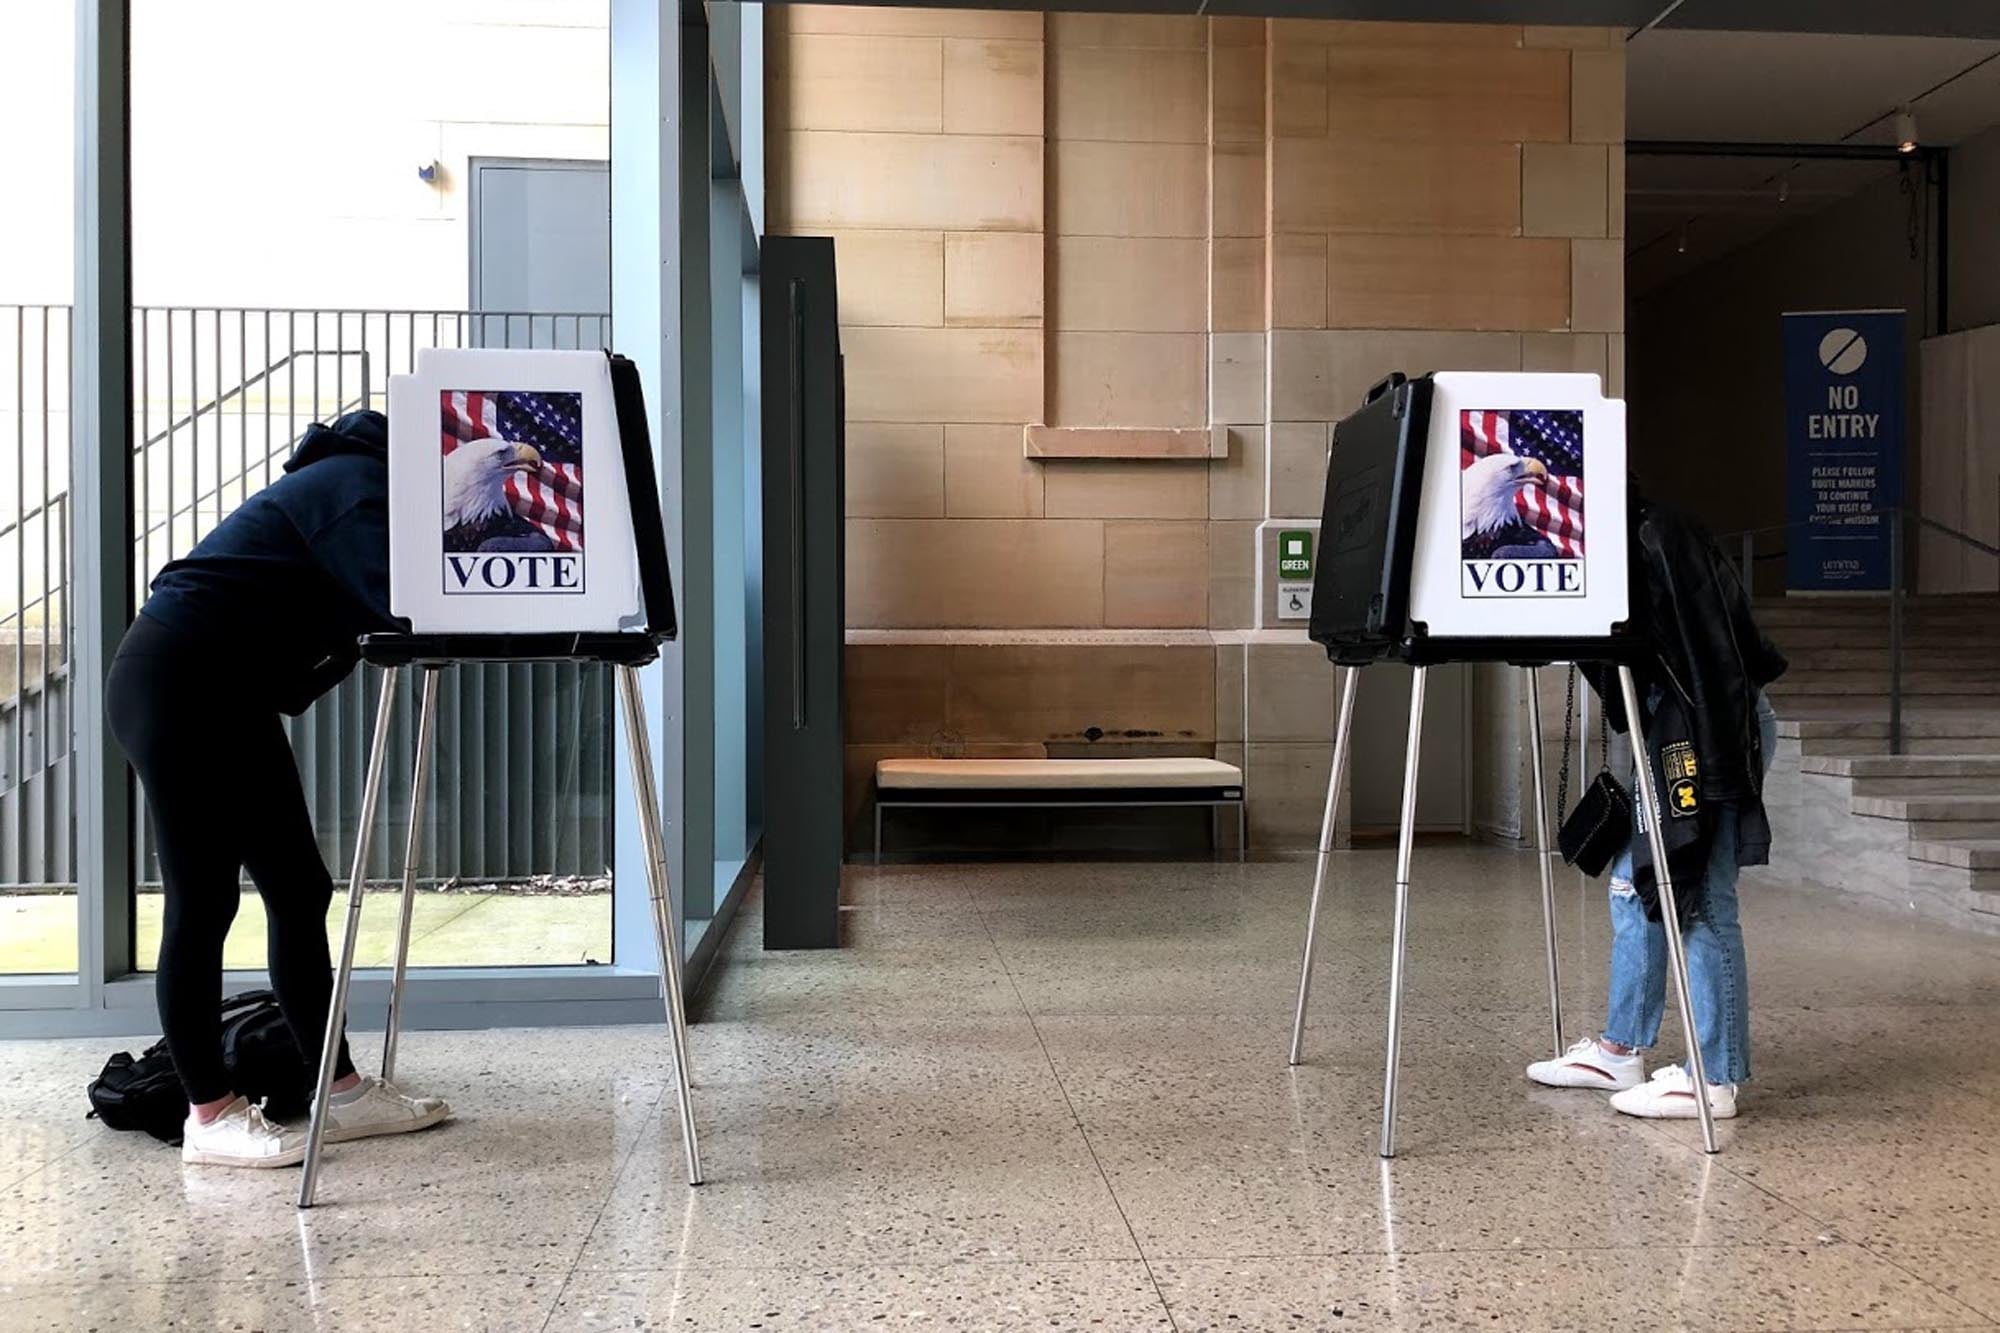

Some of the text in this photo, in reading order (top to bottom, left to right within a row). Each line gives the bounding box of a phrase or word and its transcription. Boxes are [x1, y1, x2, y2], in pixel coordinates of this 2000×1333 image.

[1828, 386, 1858, 410] NO
[1808, 415, 1879, 439] ENTRY
[1812, 466, 1876, 477] PLEASE FOLLOW
[1811, 478, 1876, 489] ROUTE MARKERS
[1818, 491, 1869, 501] TO CONTINUE
[1815, 504, 1836, 513] YOUR
[1838, 504, 1859, 513] VISIT
[1281, 560, 1309, 571] GREEN
[447, 555, 579, 589] VOTE
[1465, 561, 1581, 593] VOTE
